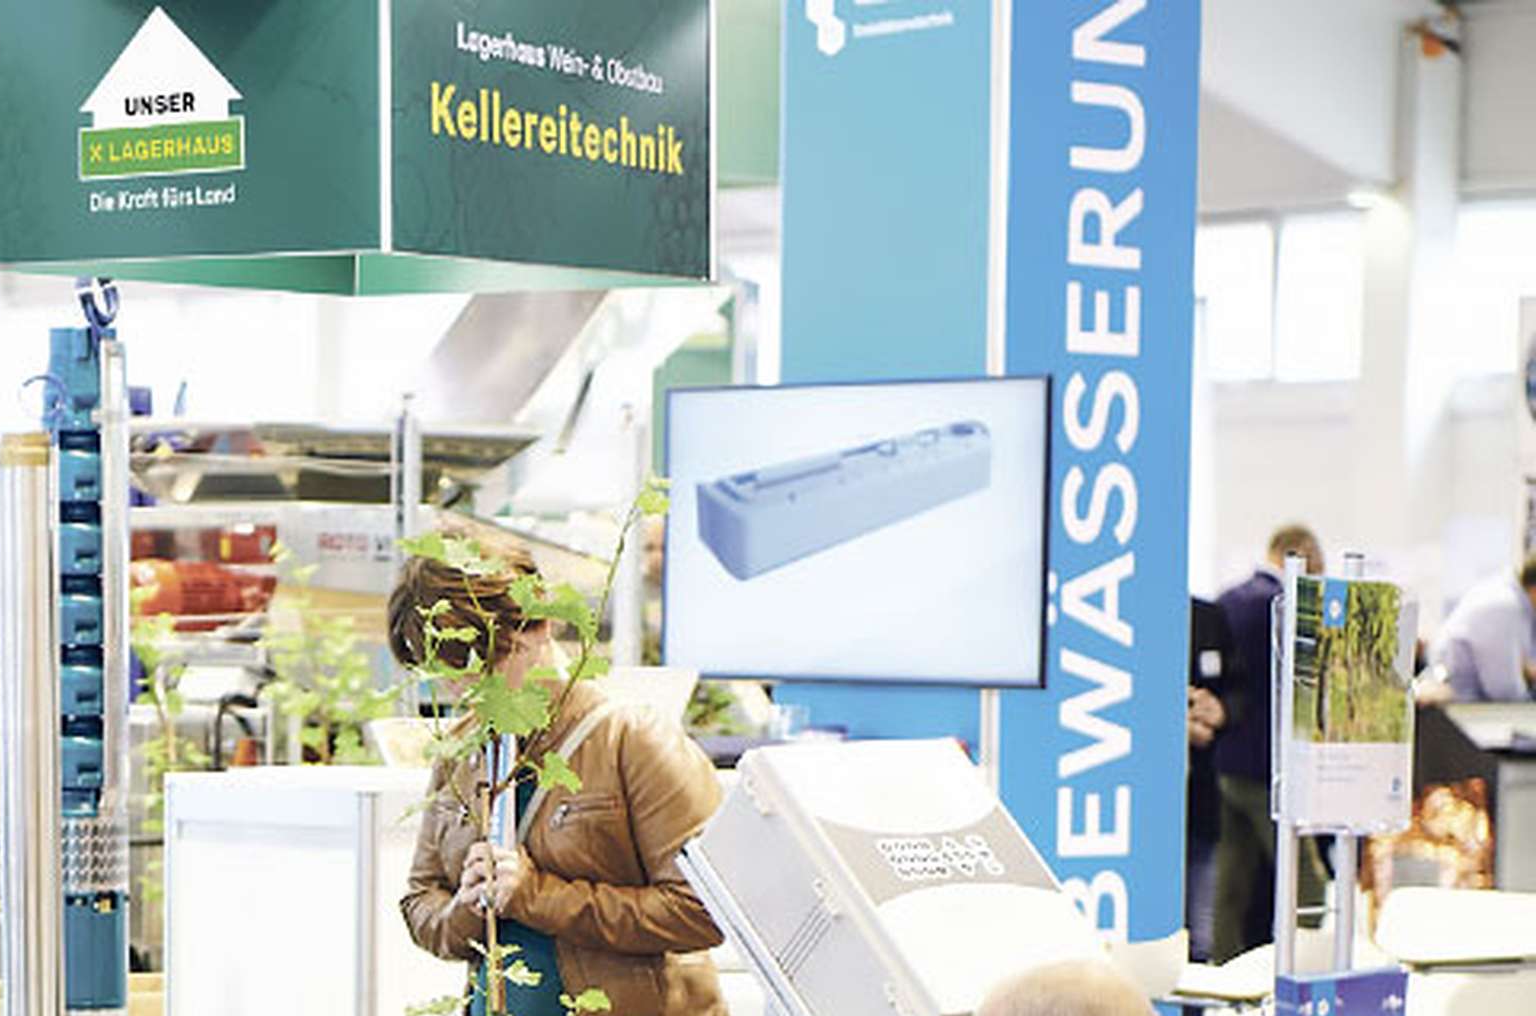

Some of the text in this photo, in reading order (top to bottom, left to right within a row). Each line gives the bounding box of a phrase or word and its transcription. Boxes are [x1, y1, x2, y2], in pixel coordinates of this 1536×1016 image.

[457, 22, 663, 94] Lagerhaus Wein- & Obstbau
[124, 92, 196, 116] UNSER
[431, 81, 684, 175] Kellereitechnik
[108, 133, 234, 163] LAGERHAUS
[89, 183, 236, 212] Die Kraft fürs Land
[1047, 0, 1146, 941] BEWÄSSERUN
